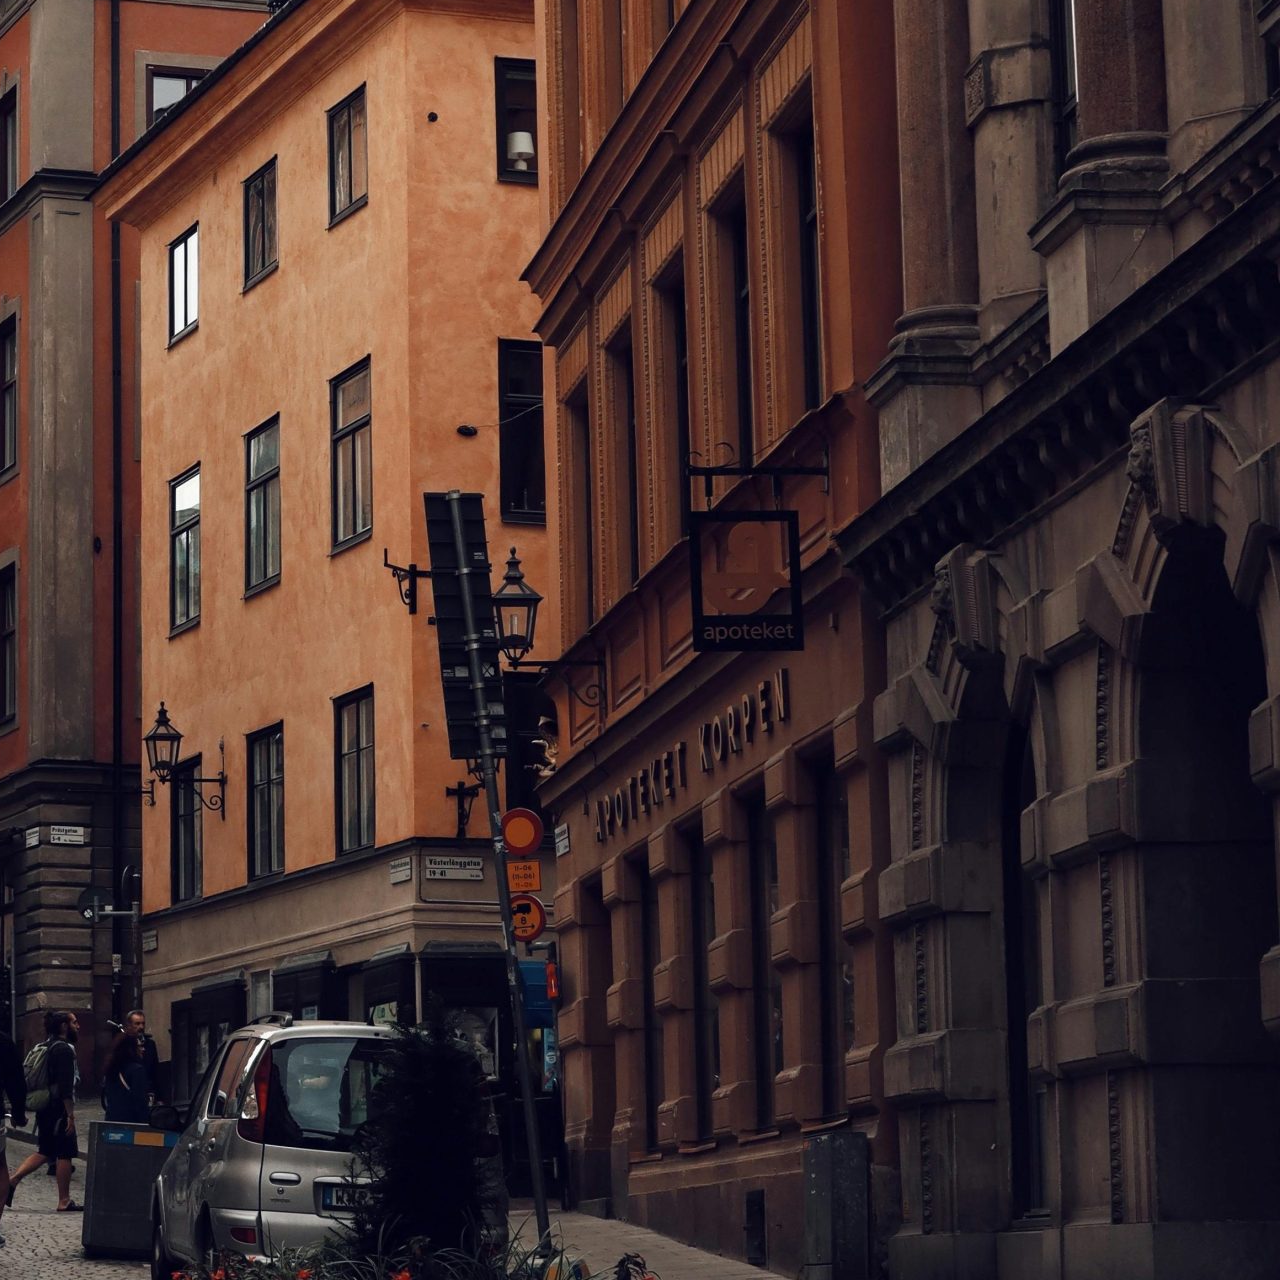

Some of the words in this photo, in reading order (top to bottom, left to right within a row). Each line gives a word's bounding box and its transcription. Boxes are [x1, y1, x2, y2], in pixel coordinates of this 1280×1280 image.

[703, 621, 795, 643] apoteket
[596, 741, 687, 842] APOTEKET
[698, 668, 788, 773] KORPEN
[428, 858, 481, 868] Västerlånggatan
[520, 916, 527, 925] 8
